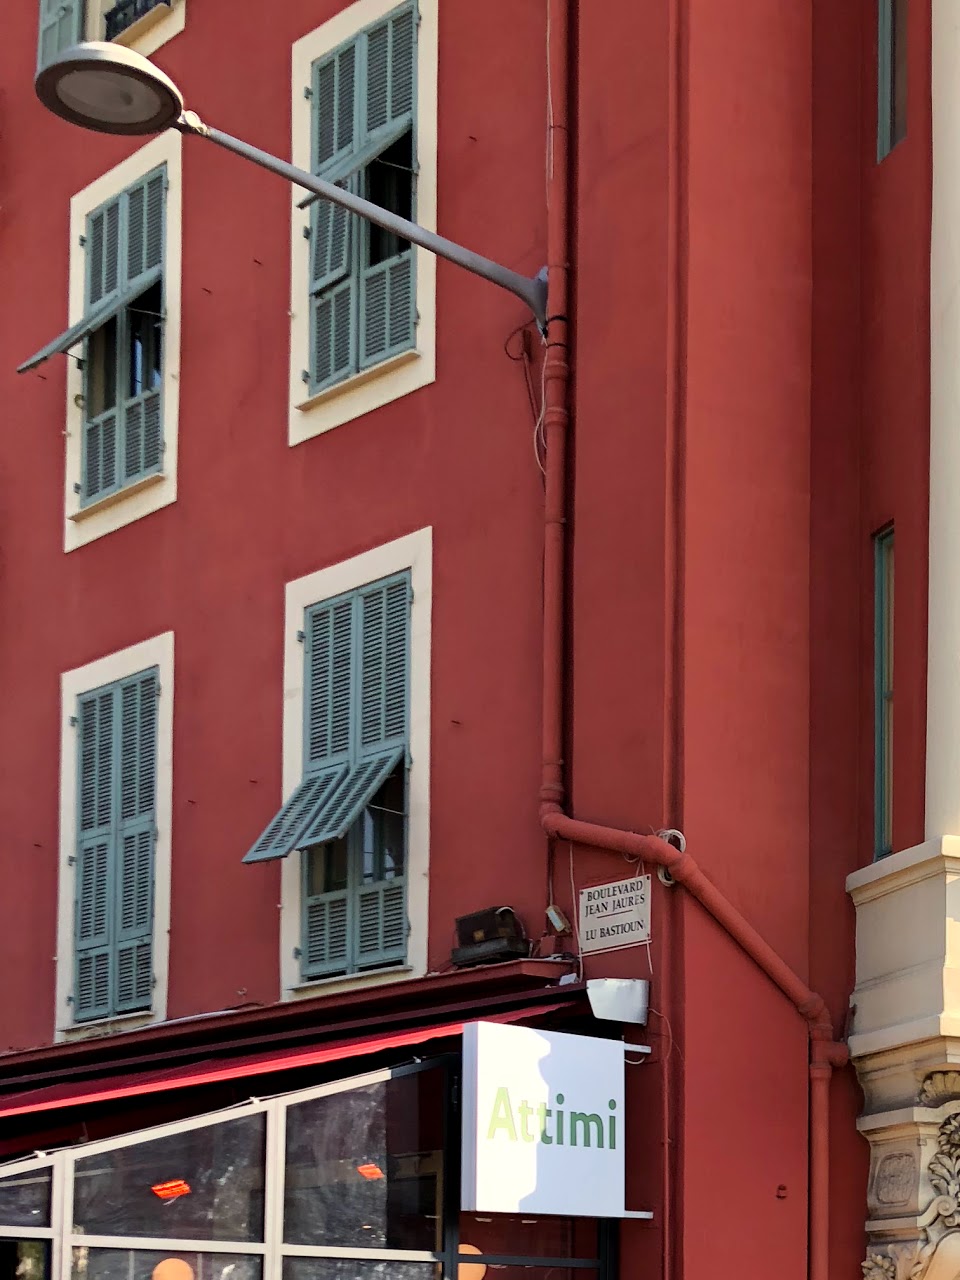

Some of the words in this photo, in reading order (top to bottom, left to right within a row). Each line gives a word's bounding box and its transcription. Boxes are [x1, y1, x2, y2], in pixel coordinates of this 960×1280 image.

[587, 880, 643, 902] BOULEVARD
[585, 901, 609, 917] JEAN
[585, 930, 597, 941] LU
[599, 920, 644, 938] BASTIOUN
[486, 1086, 617, 1150] Attimi
